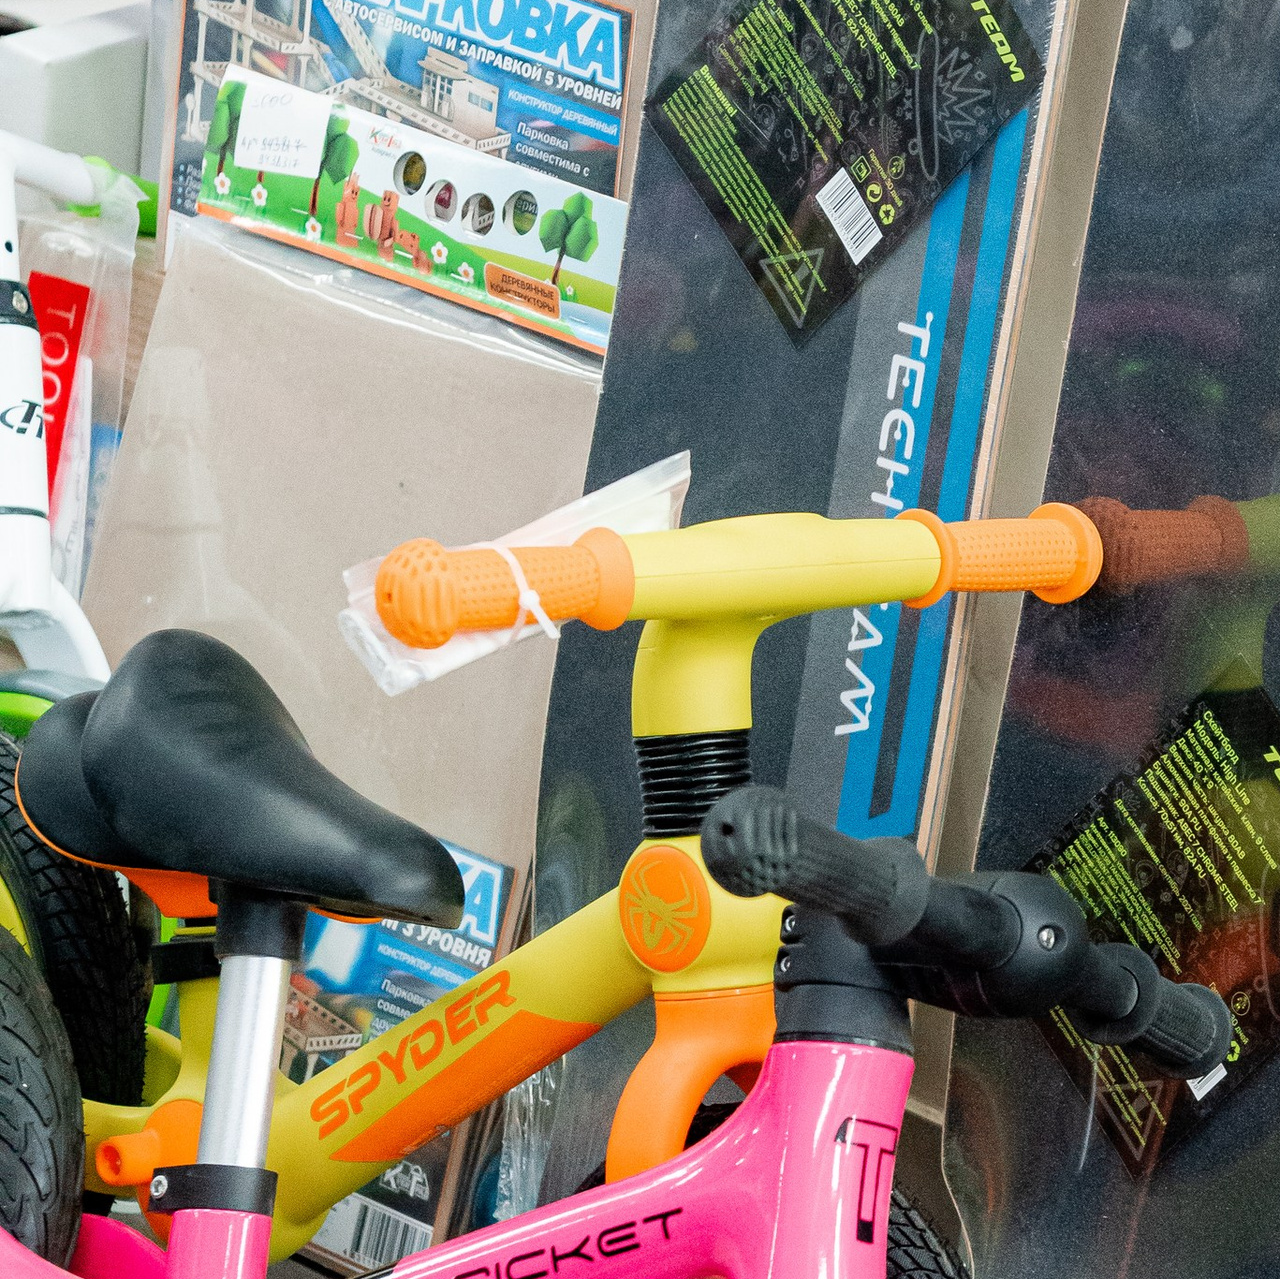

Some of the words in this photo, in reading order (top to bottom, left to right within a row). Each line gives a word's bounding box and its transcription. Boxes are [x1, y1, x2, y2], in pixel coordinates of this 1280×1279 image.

[445, 34, 457, 52] И
[458, 39, 543, 82] ЗАПРАВКОЙ
[544, 70, 555, 86] 5
[556, 73, 623, 111] УРОВНЕЙ
[700, 66, 736, 116] Внимание!
[508, 89, 563, 116] КОНСТРУКТОР
[562, 111, 619, 137] ДЕРЕВЯННЫЙ
[517, 121, 569, 150] Парковка
[515, 142, 581, 174] совместима
[583, 166, 591, 177] с
[870, 150, 889, 179] Гарантия
[884, 176, 896, 192] 30
[891, 190, 903, 206] дней
[501, 273, 555, 301] ДЕРЕВЯННЫЕ
[835, 311, 934, 735] TECHAM
[1176, 738, 1194, 760] Дека:
[1193, 720, 1222, 762] Модель:
[1221, 761, 1237, 788] High
[1234, 786, 1251, 805] Line
[1203, 711, 1239, 764] Скейтборд
[1153, 760, 1181, 800] Бушинги:
[1190, 816, 1201, 832] PU
[1168, 744, 1194, 780] Верхняя
[1193, 780, 1208, 805] часть:
[1208, 804, 1230, 836] шкурка
[1186, 729, 1214, 773] Материал:
[1213, 772, 1244, 816] китайский
[1243, 818, 1255, 835] клен,
[1255, 837, 1263, 845] 9
[1260, 847, 1277, 869] слоев
[1097, 816, 1109, 830] Арт.
[1109, 832, 1127, 857] 113090
[1137, 778, 1159, 809] Колеса:
[1159, 807, 1177, 833] 70x51
[1173, 832, 1184, 847] мм,
[1194, 864, 1206, 879] PU
[1146, 768, 1179, 817] Подшипник:
[1176, 818, 1195, 842] ABEC
[1196, 846, 1222, 886] CHROME
[1219, 883, 1238, 910] STEEL
[1161, 754, 1200, 810] Алюминиевая
[1198, 809, 1229, 855] платформа
[1227, 853, 1233, 861] и
[1231, 860, 1256, 899] подвеска
[1114, 798, 1129, 818] Дата
[1127, 816, 1160, 864] изготовления:
[1159, 864, 1180, 897] сентябрь
[1179, 896, 1193, 914] 2021
[377, 943, 432, 975] КОНСТРУКТОР
[416, 925, 492, 968] УРОВНЯ
[377, 999, 415, 1019] совме
[310, 969, 518, 1141] SPYDER
